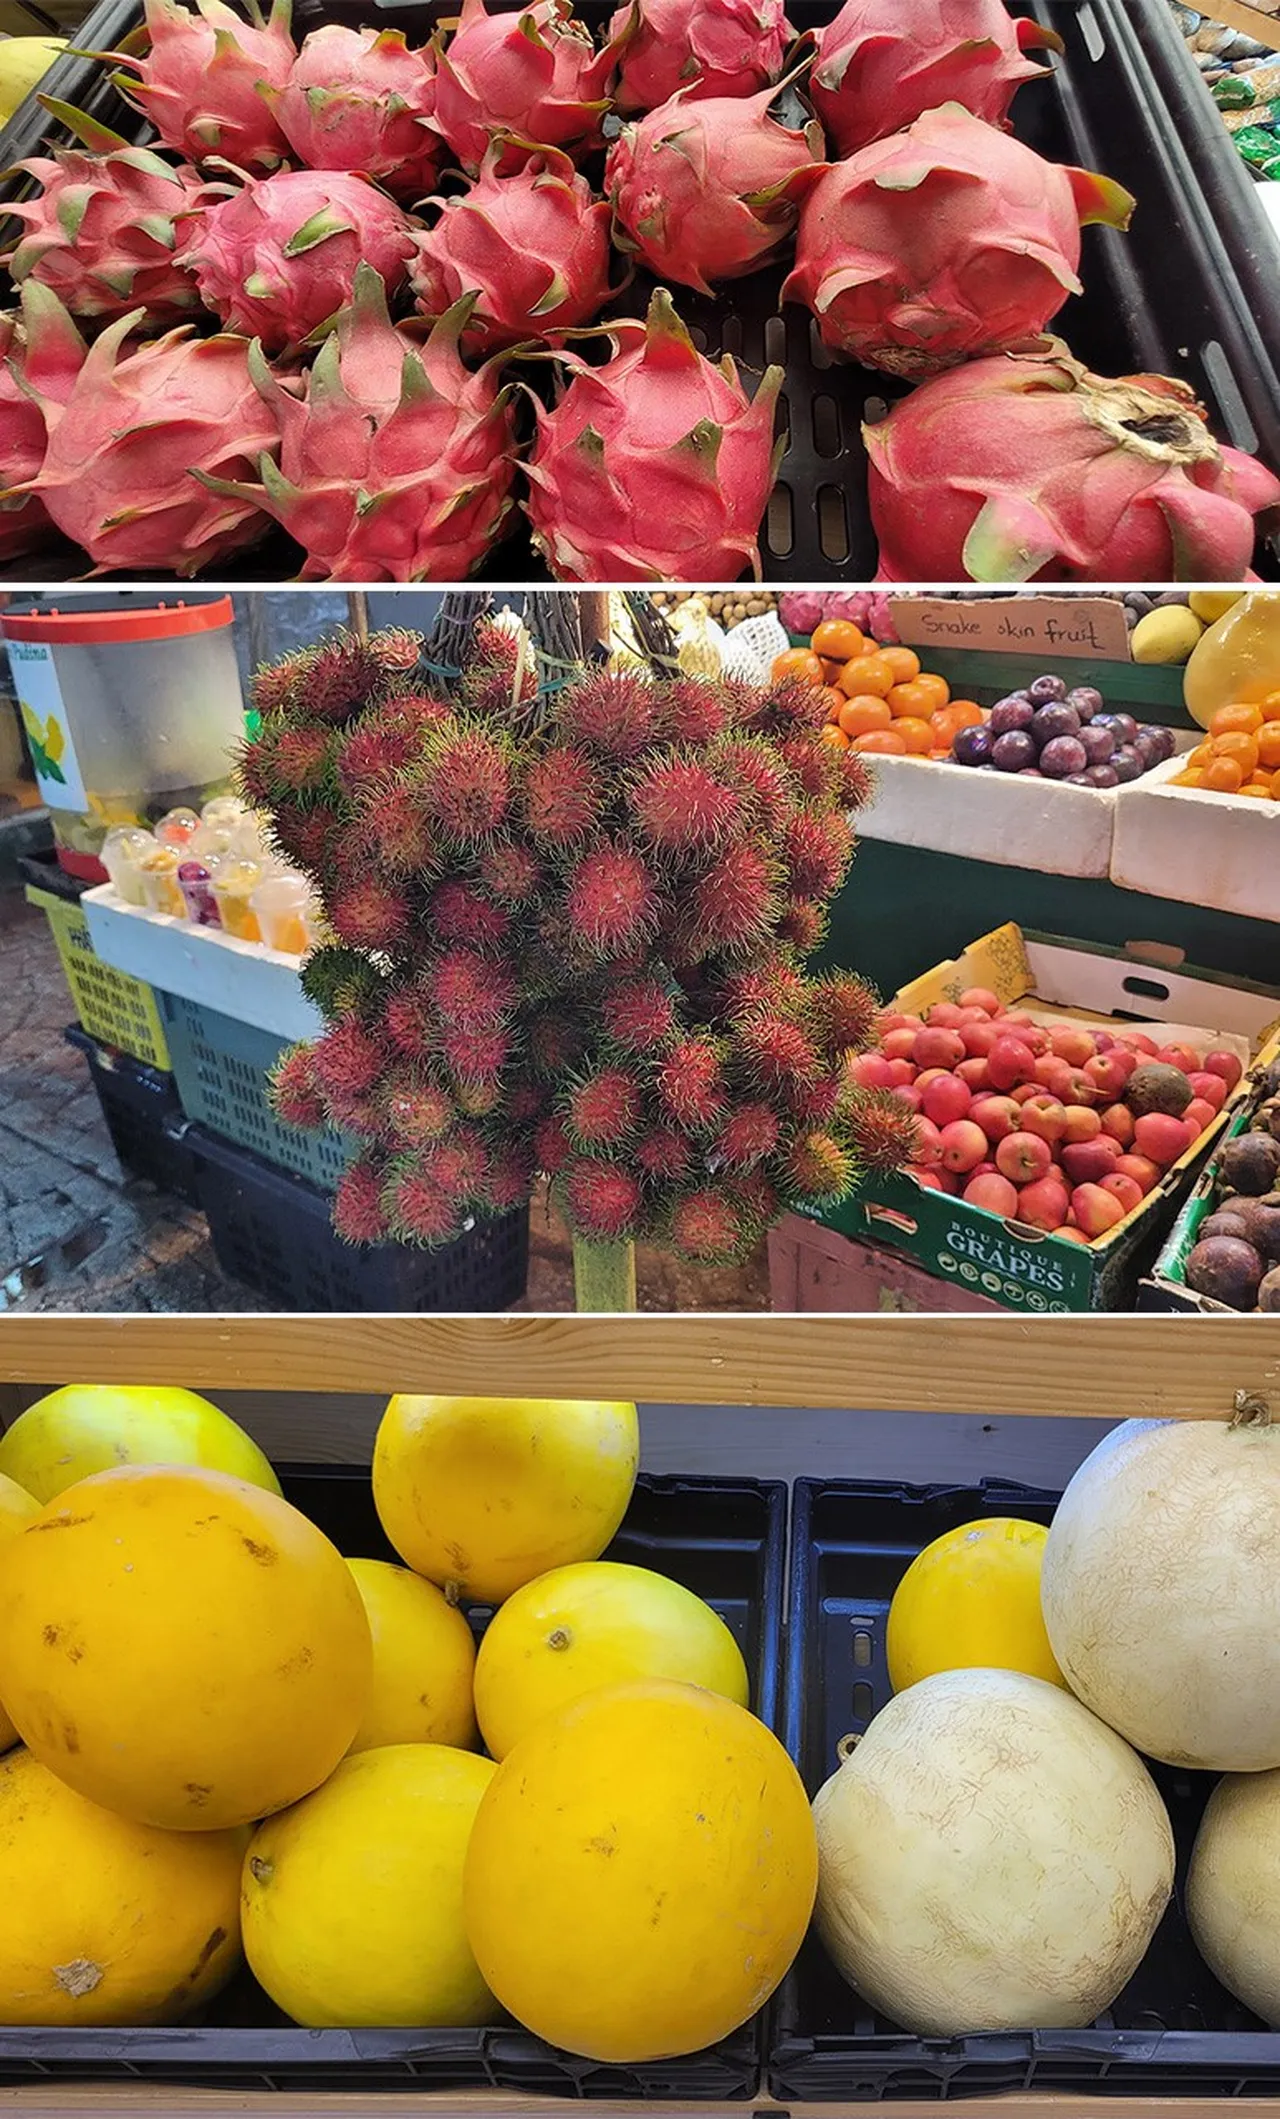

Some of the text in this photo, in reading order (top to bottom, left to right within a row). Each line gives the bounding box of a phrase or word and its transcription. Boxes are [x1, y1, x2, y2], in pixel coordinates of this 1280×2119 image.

[922, 614, 1105, 650] Snake skin fruit
[946, 1231, 1064, 1292] GRAPES
[952, 1221, 1062, 1271] BOUTIQUE
